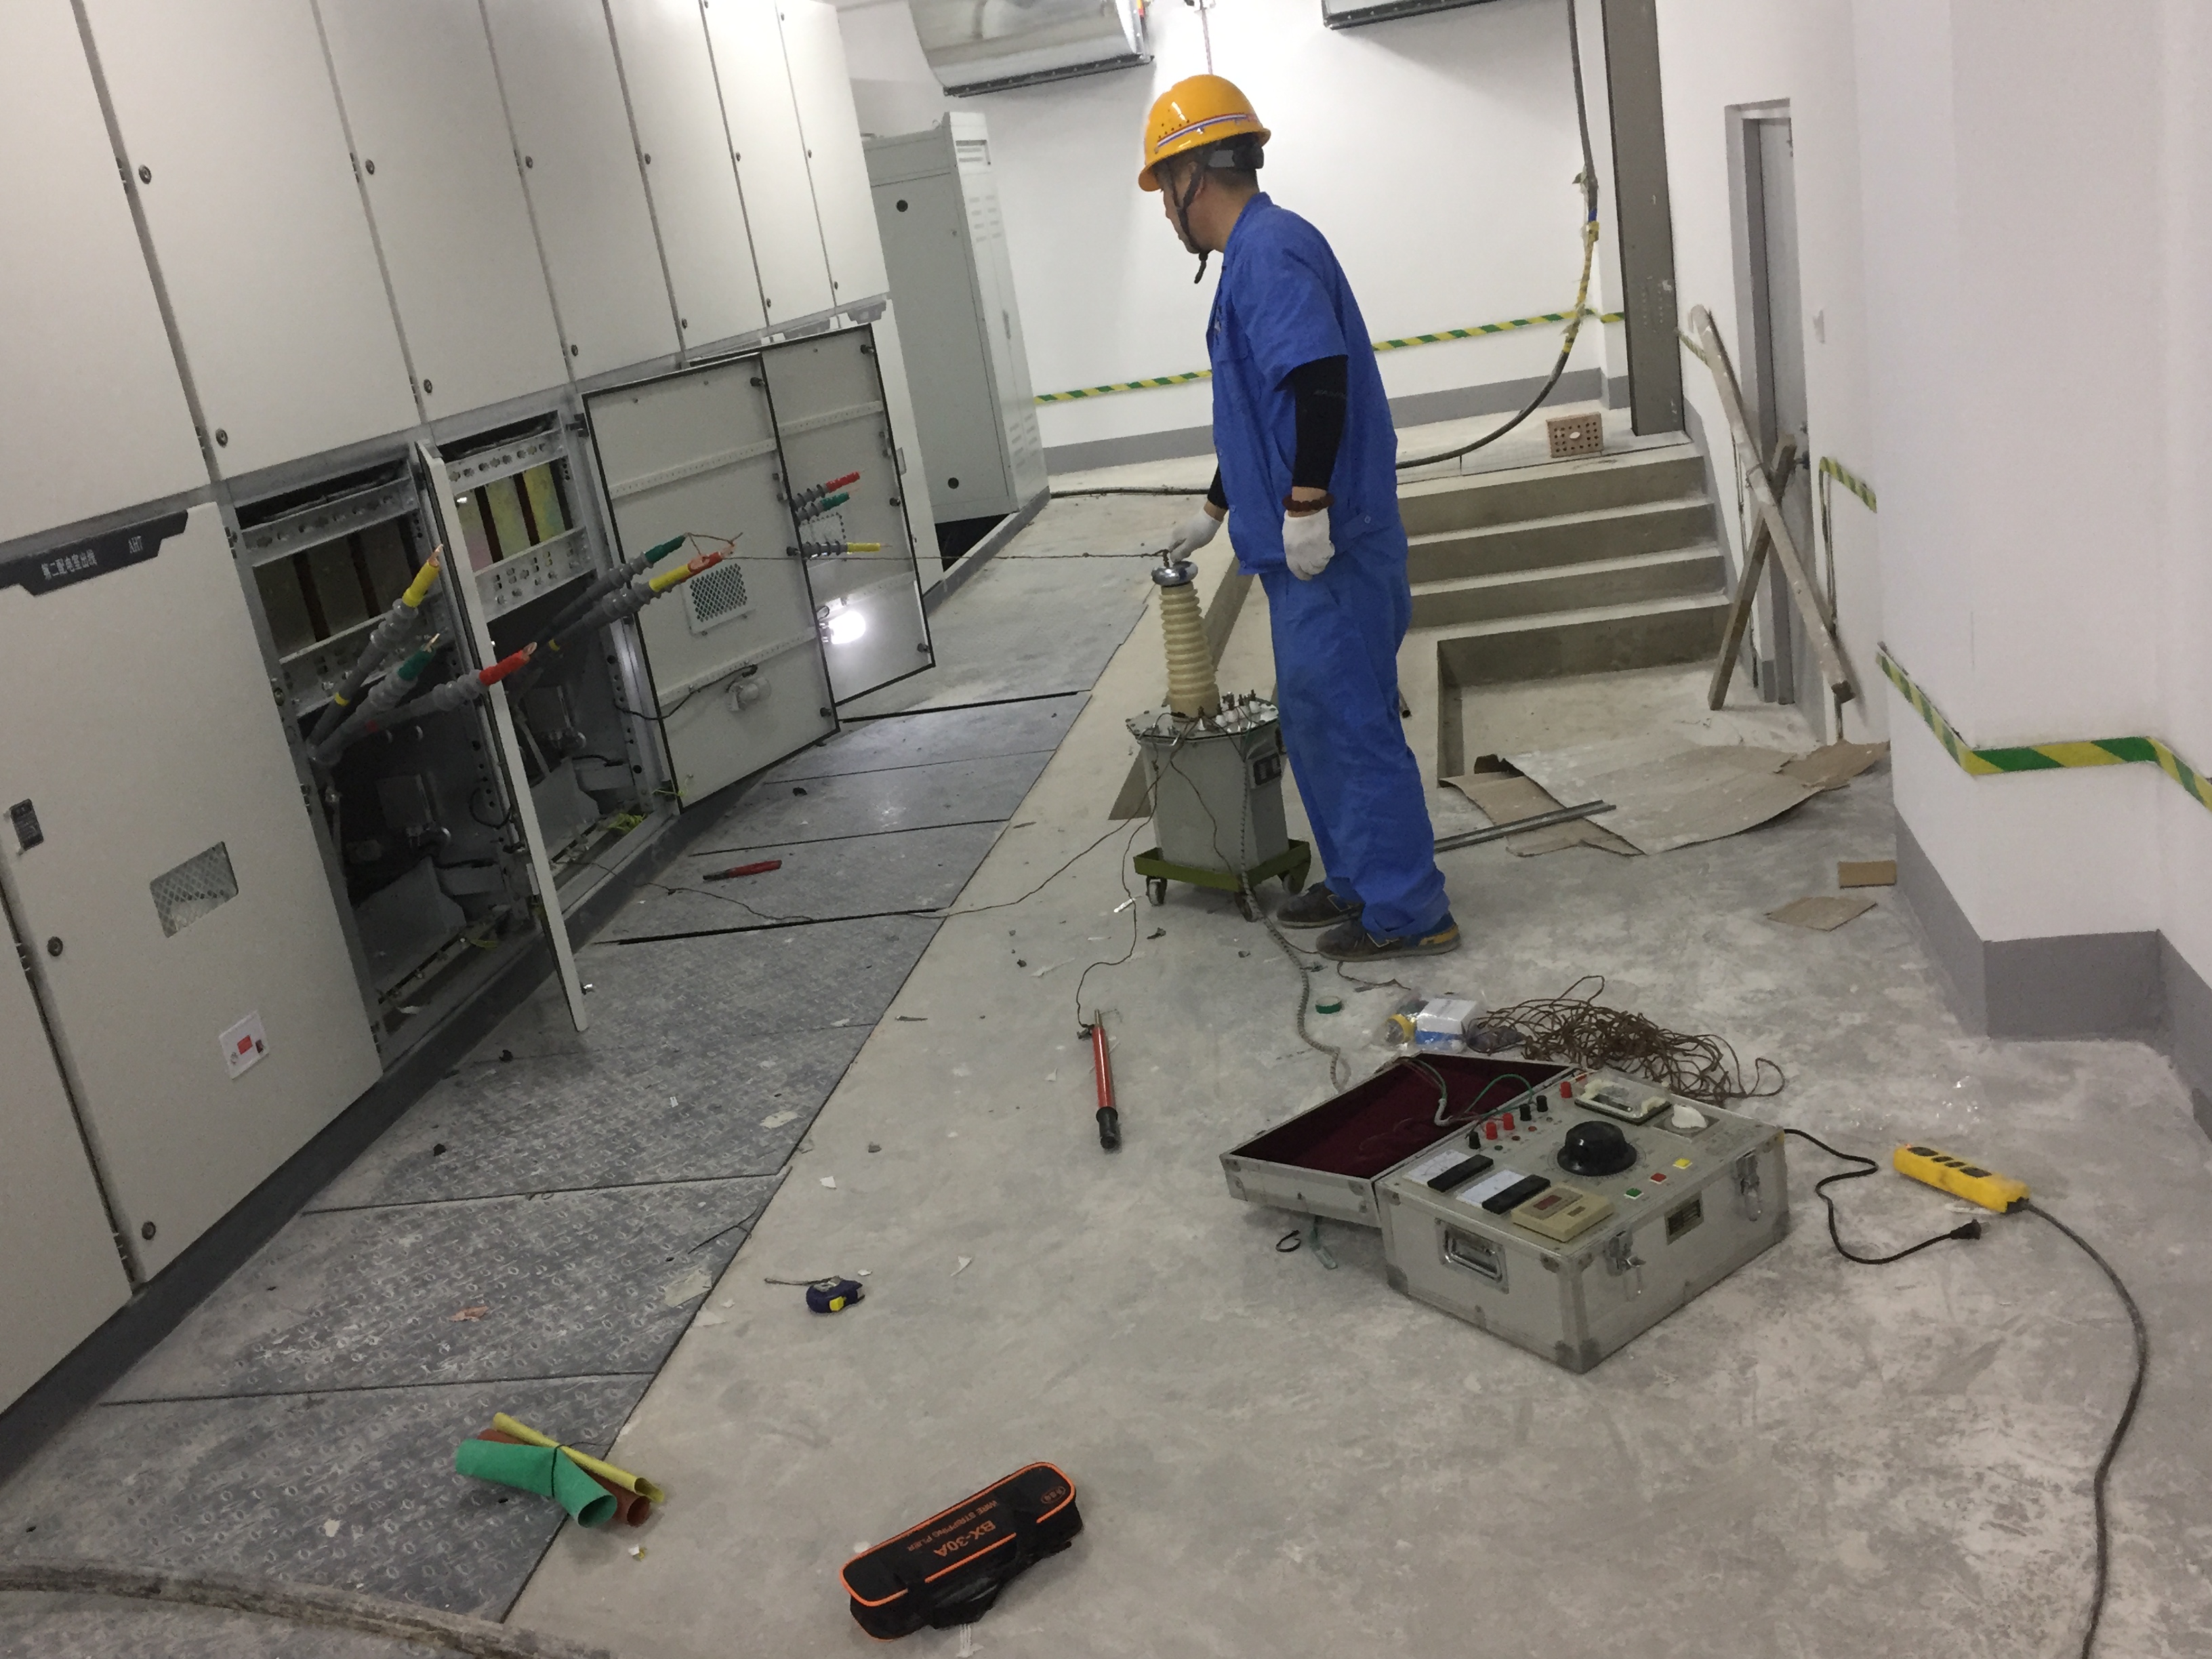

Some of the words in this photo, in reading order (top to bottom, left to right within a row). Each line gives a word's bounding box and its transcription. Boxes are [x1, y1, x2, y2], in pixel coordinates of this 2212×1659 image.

[976, 1500, 998, 1515] WIRE
[932, 1512, 976, 1538] STRIPPING
[933, 1520, 996, 1557] BX-30A
